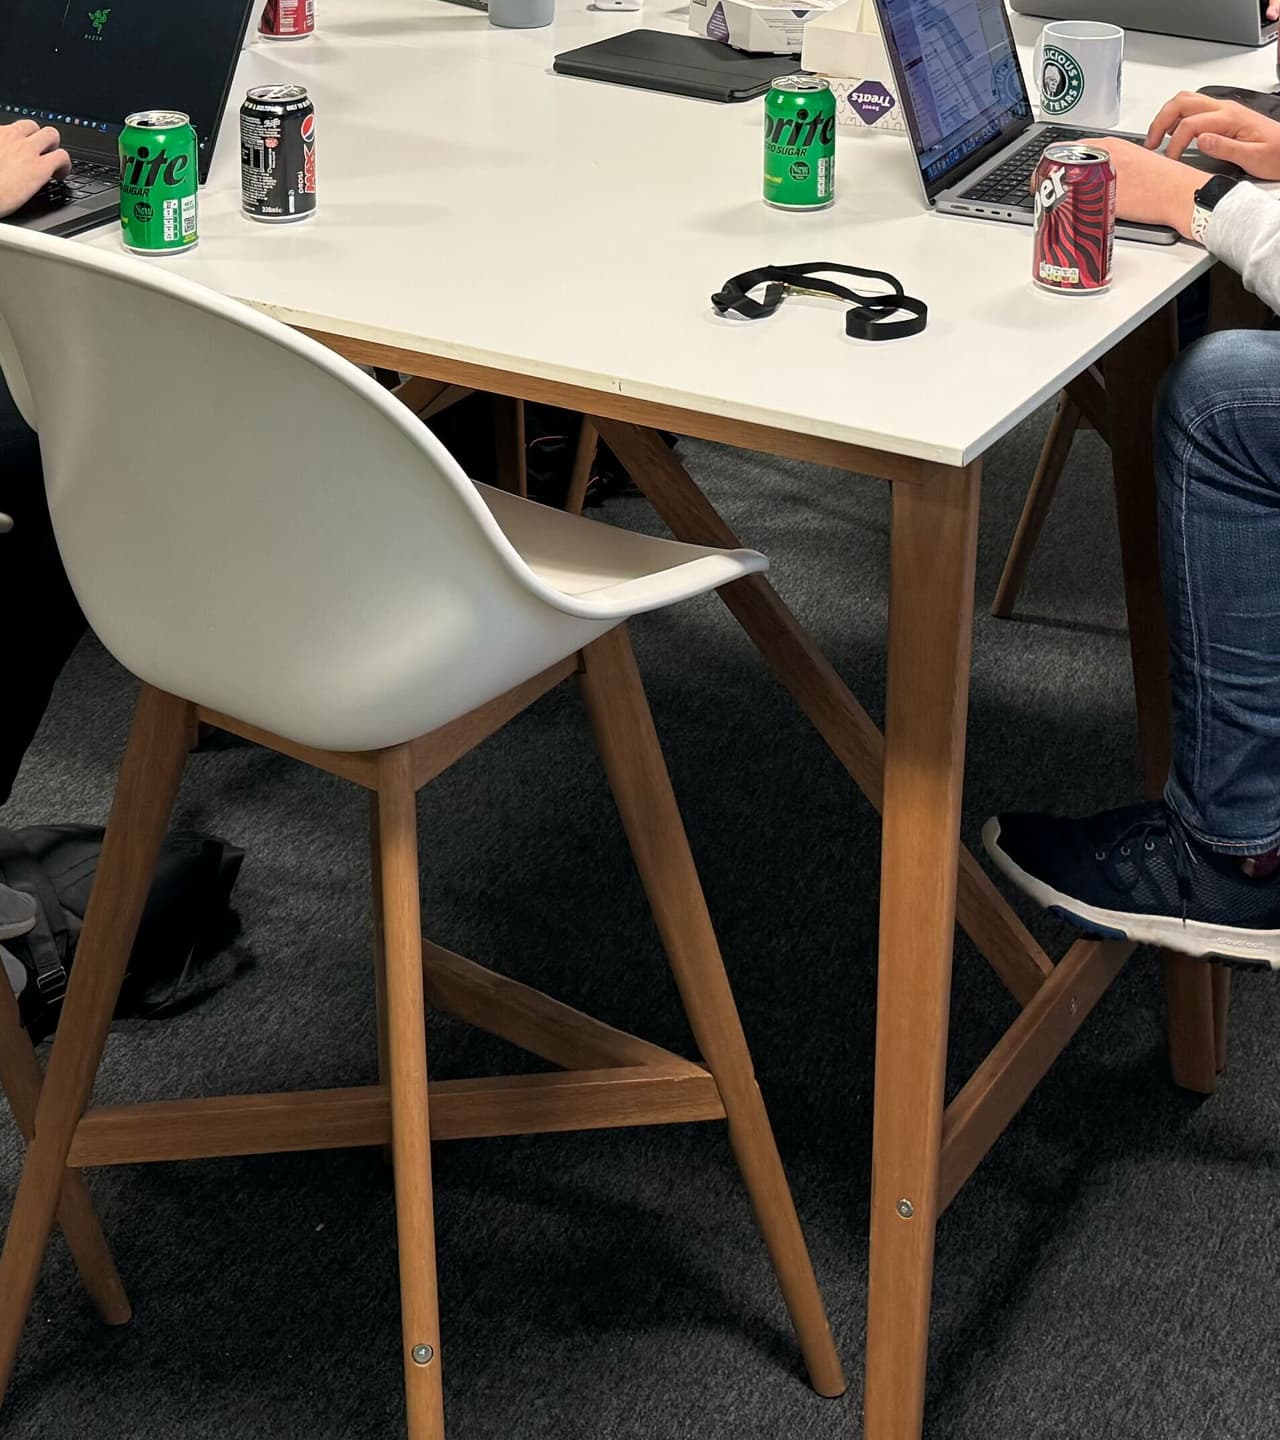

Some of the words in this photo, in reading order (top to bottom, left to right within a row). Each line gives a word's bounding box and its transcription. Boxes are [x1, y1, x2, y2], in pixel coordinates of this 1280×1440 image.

[1043, 49, 1078, 77] LICIOUS
[851, 92, 891, 107] Treats
[1050, 89, 1078, 110] TEARS
[776, 146, 807, 157] SUGAR
[120, 146, 189, 186] rite
[123, 185, 150, 197] SUGAR
